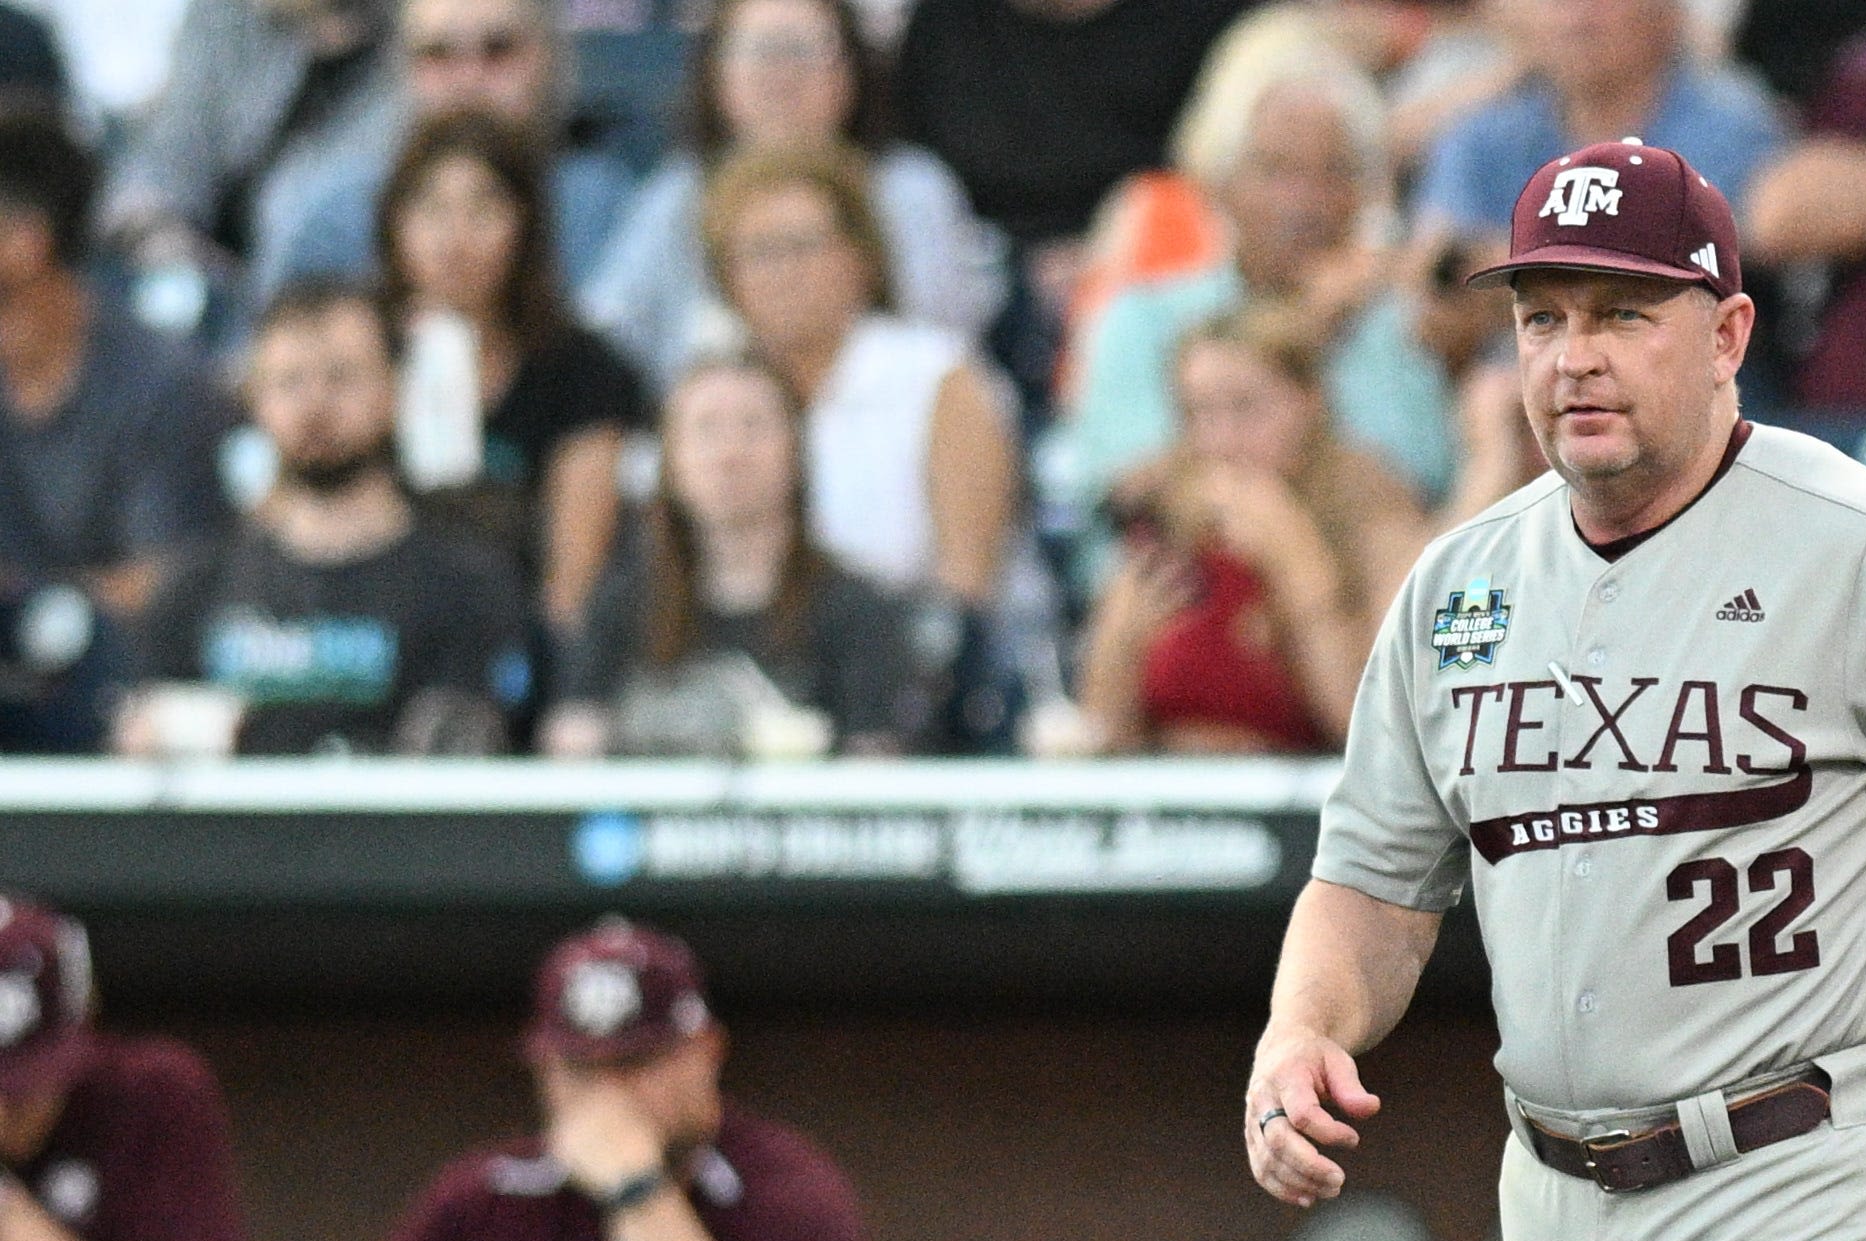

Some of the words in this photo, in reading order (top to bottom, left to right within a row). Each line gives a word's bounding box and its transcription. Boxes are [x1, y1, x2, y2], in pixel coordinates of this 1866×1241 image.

[1450, 617, 1494, 631] COLLEGE
[1715, 609, 1765, 623] adidas
[1433, 631, 1471, 647] WORLD
[1470, 629, 1505, 644] SERIES
[1451, 674, 1809, 776] TEXAS
[1509, 805, 1660, 847] AGGIES
[1665, 846, 1821, 988] 22
